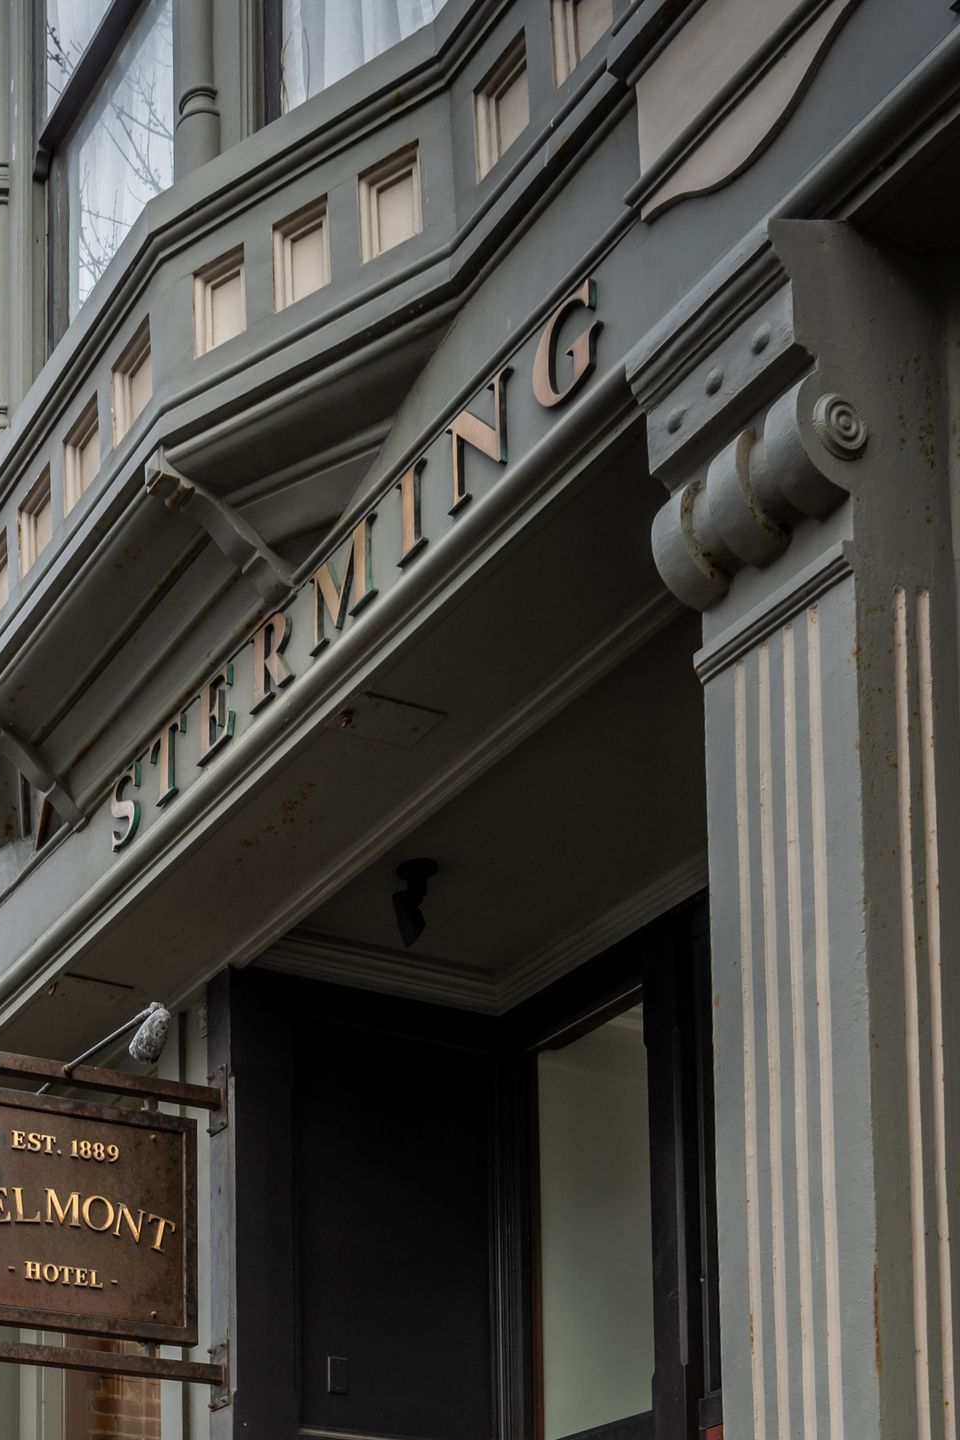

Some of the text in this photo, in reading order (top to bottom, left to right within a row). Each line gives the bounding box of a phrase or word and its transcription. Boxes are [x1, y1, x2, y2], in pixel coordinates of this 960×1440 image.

[111, 278, 604, 852] STERMING
[11, 1129, 120, 1163] EST. 1889
[24, 1260, 103, 1289] HOTEL
